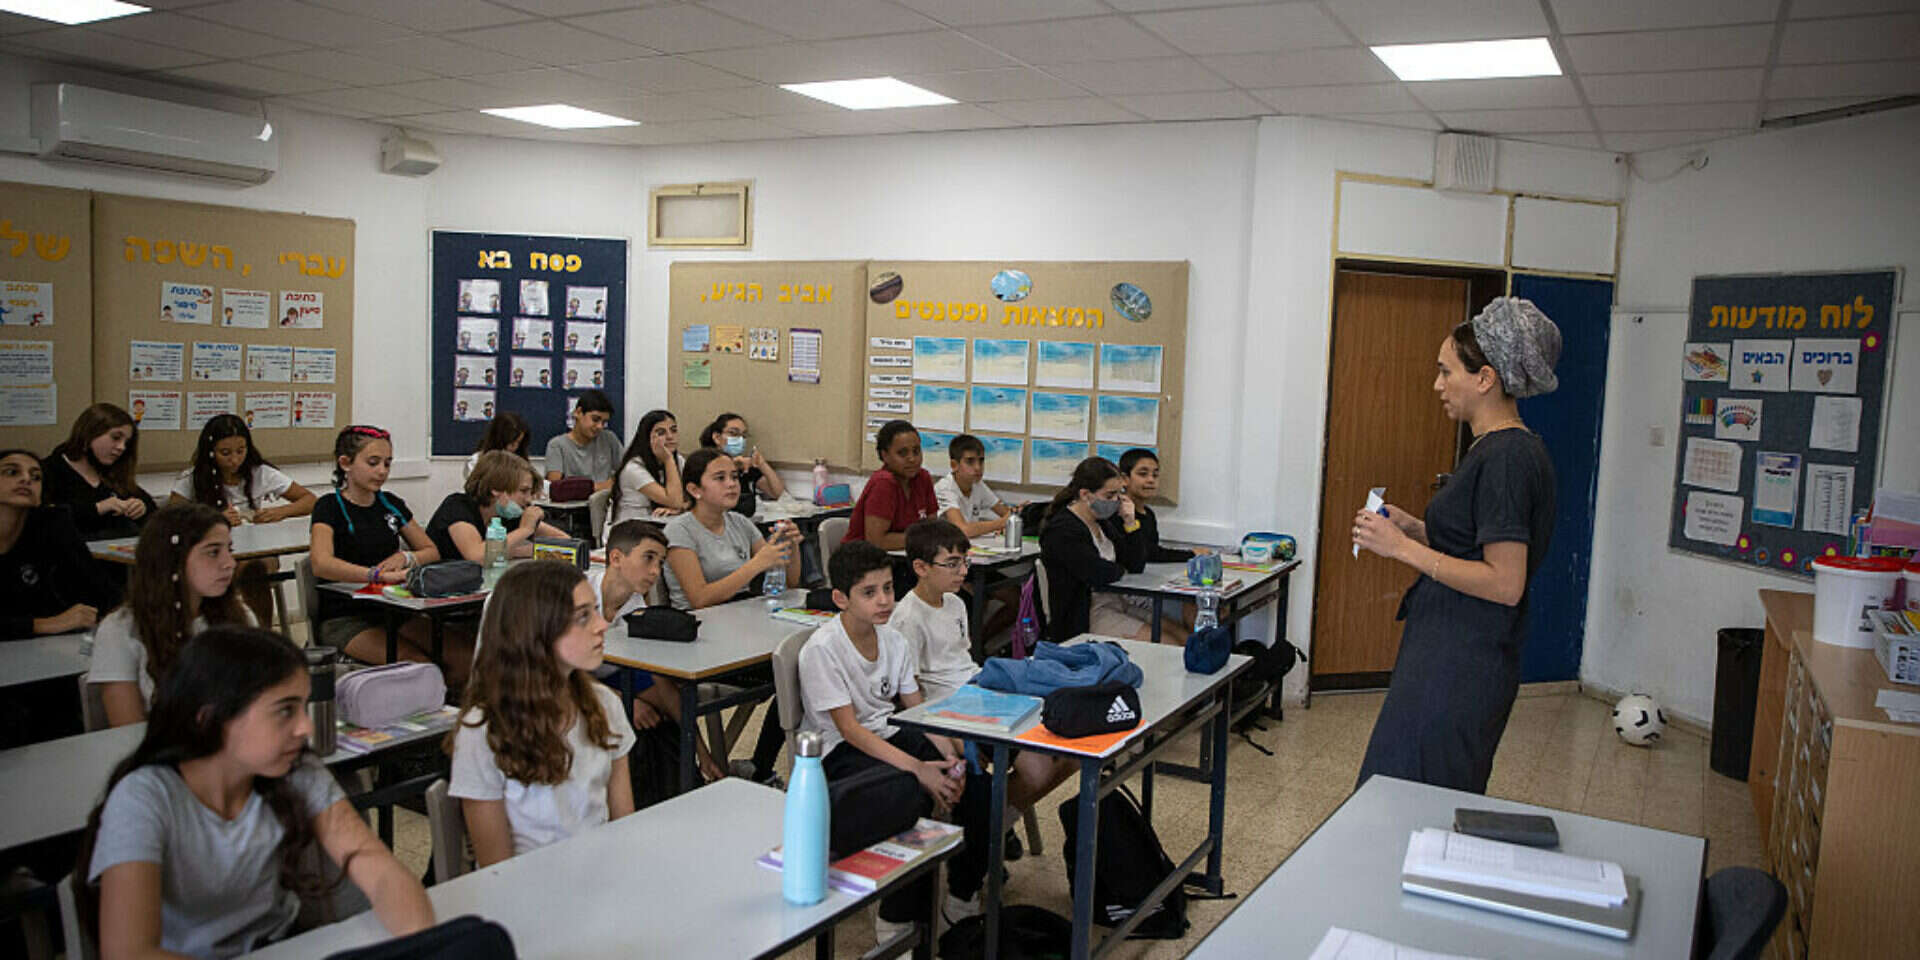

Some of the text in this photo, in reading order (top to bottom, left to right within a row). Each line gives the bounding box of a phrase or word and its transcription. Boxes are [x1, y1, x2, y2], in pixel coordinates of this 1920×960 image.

[477, 249, 583, 272] פסח בא
[777, 282, 833, 304] אביב
[892, 298, 1104, 330] המצאות ופטנטים
[1708, 294, 1875, 330] לוח מודעות
[1742, 350, 1785, 365] הבאים
[1802, 350, 1854, 365] ברוכים
